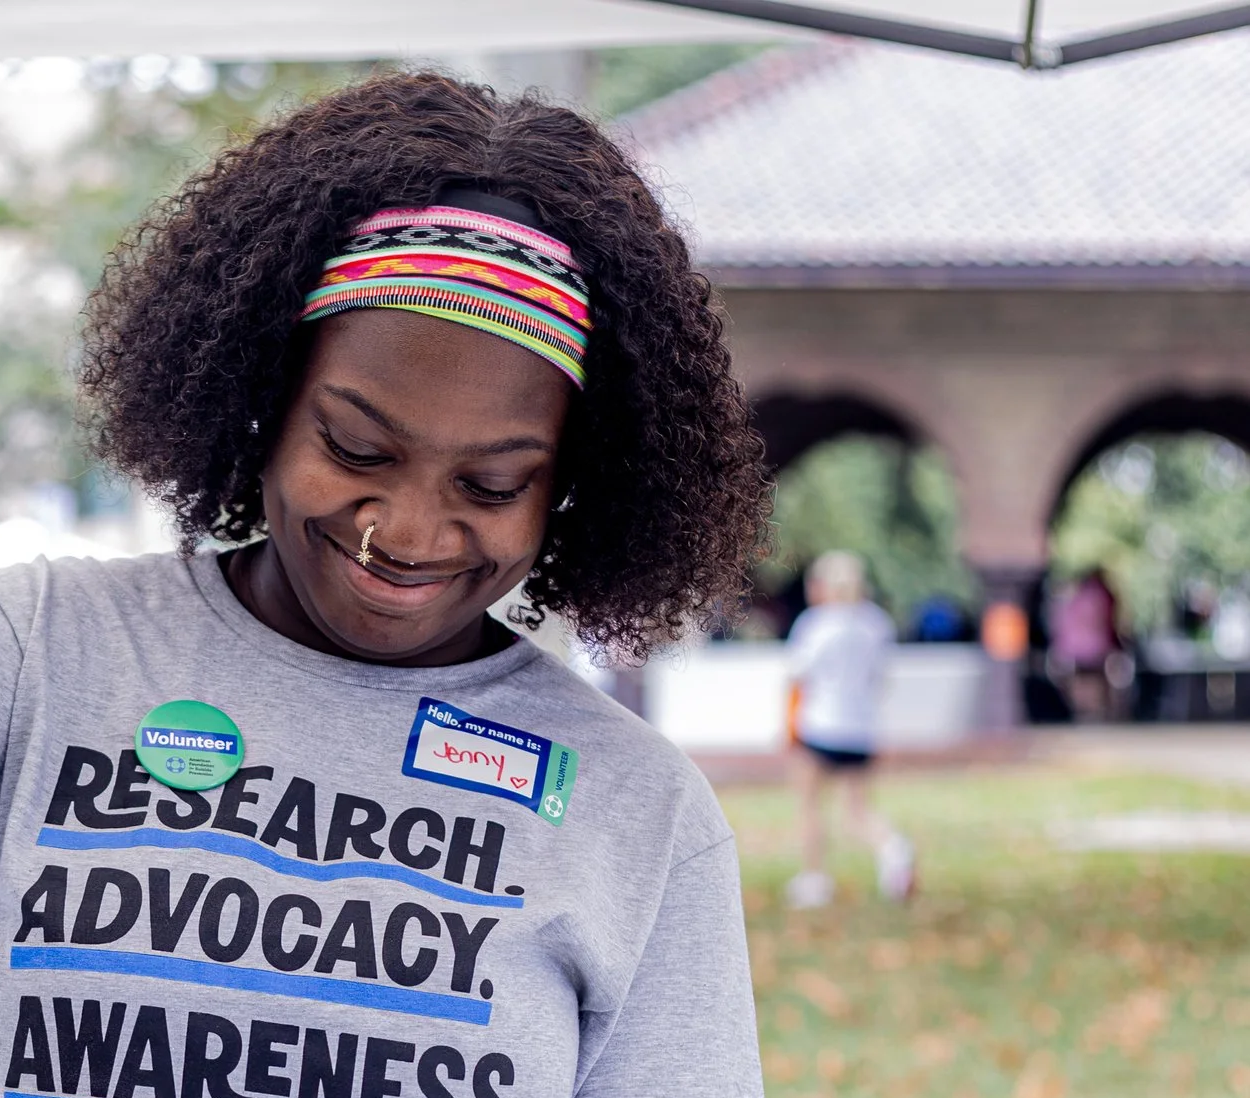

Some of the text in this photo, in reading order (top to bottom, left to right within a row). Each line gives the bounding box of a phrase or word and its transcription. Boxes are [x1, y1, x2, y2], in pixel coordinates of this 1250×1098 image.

[145, 730, 234, 751] Volunteer
[426, 704, 542, 752] Hello, my name is:
[433, 741, 506, 782] Jenny
[555, 751, 570, 792] VOLUNTEER
[13, 865, 499, 1000] ADVOCACY.
